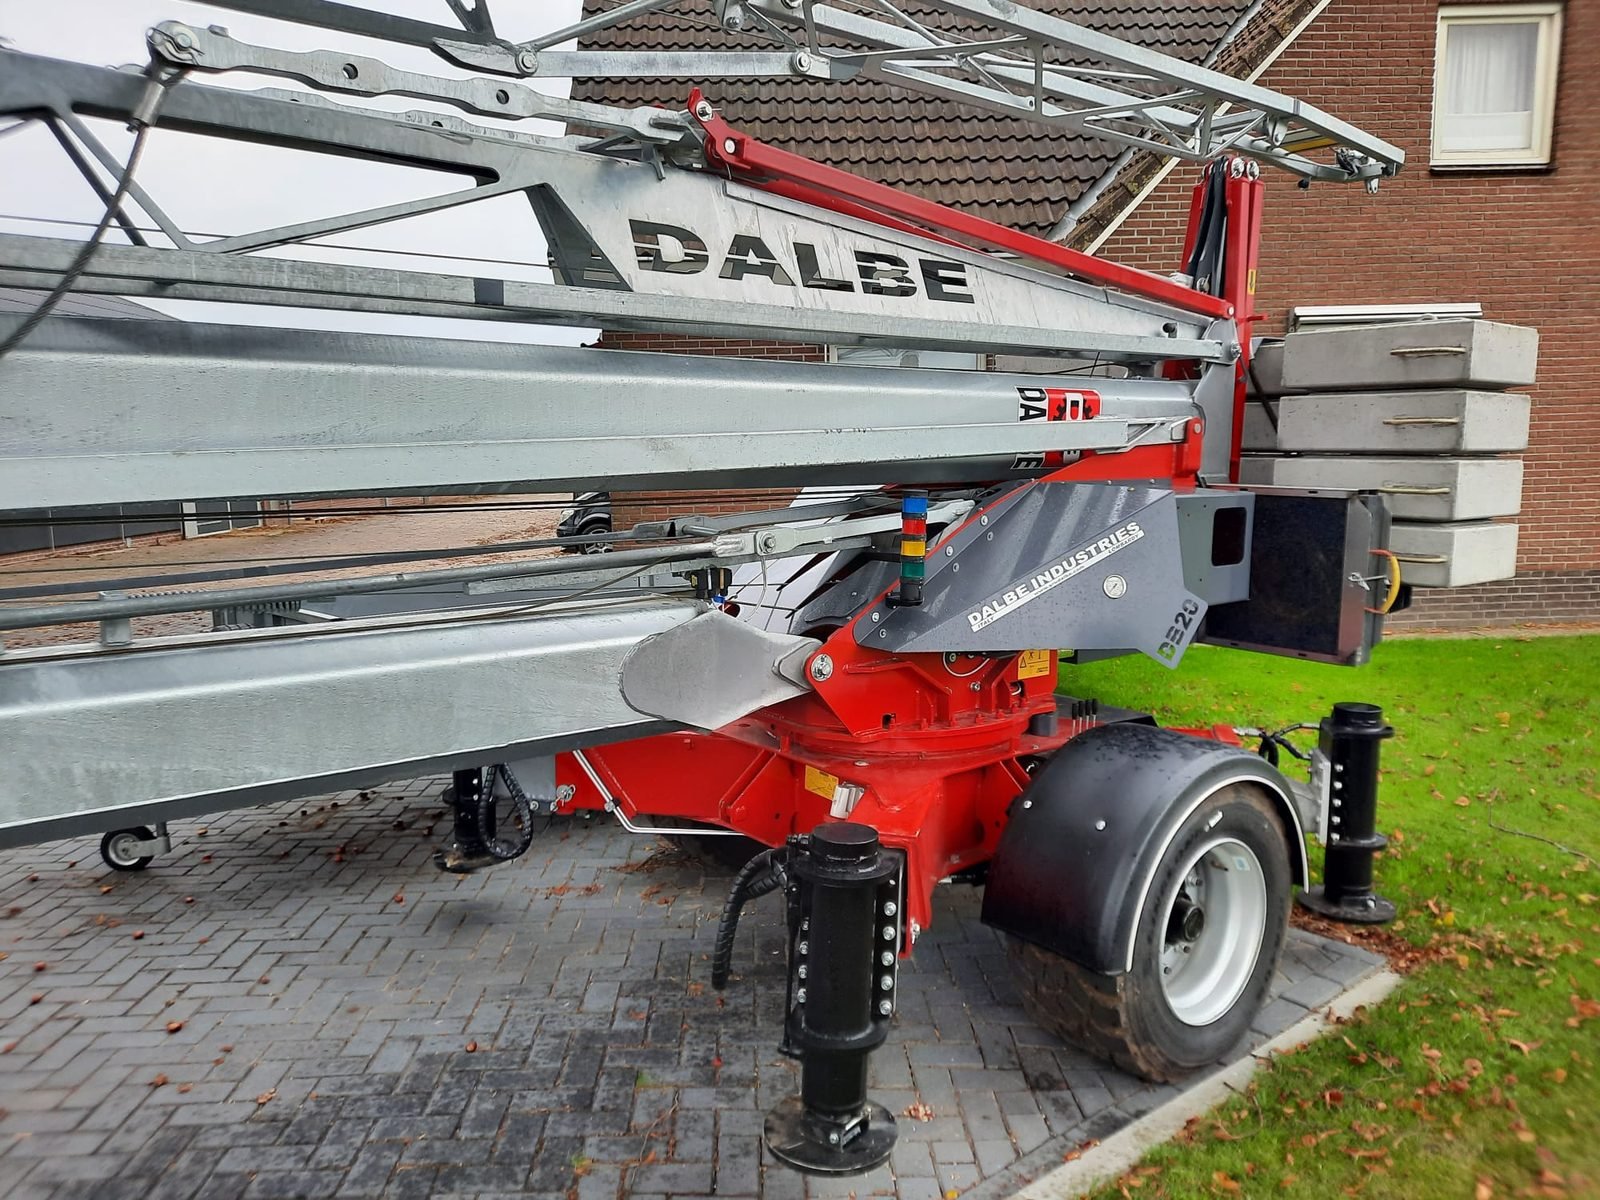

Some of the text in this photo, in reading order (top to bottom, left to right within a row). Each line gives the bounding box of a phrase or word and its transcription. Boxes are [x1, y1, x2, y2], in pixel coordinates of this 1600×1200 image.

[629, 219, 975, 304] DALBE
[1108, 534, 1139, 553] LOMBARDY
[967, 521, 1140, 626] DALBE INDUSTRIES
[977, 617, 994, 629] ITALY
